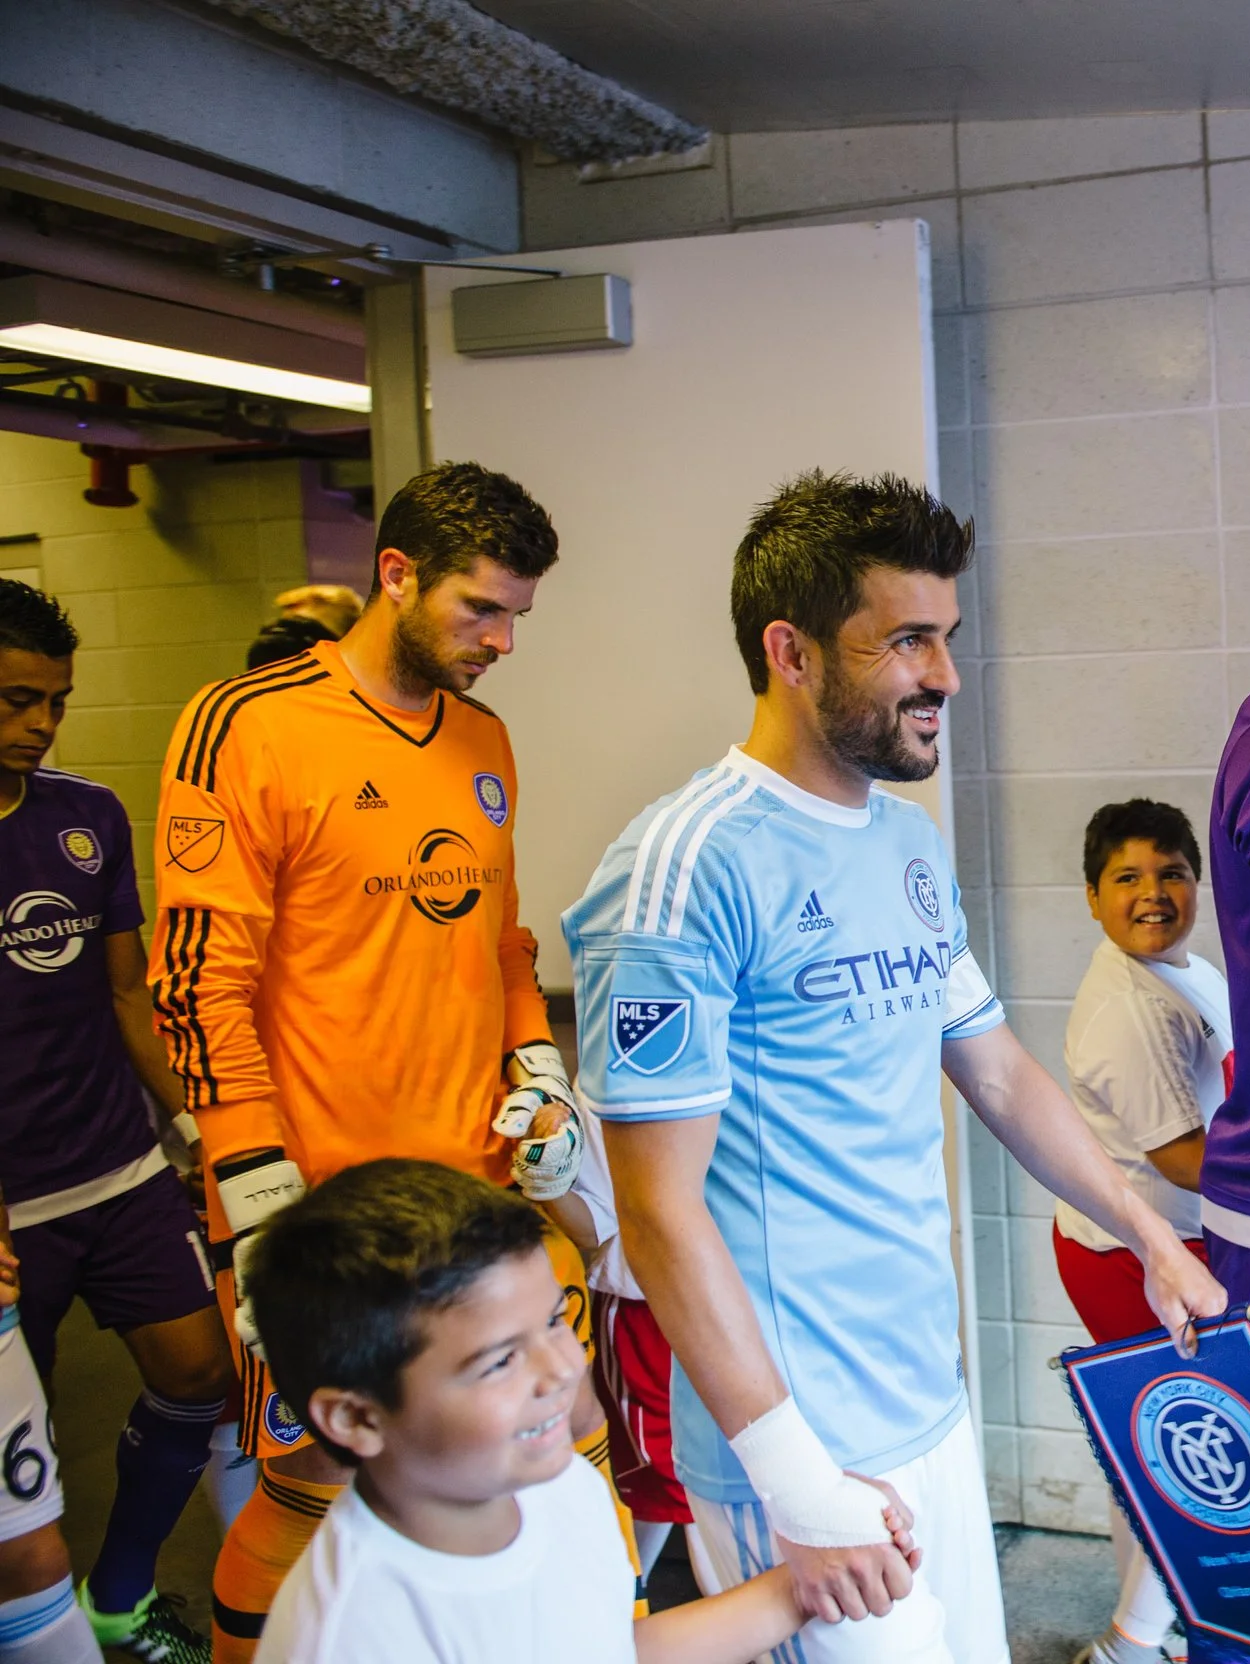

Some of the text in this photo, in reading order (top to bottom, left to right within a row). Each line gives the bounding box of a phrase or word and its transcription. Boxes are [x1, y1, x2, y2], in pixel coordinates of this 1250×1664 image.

[354, 799, 389, 810] adidas
[173, 821, 202, 833] MLS
[364, 870, 454, 896] ORLANDO
[797, 916, 834, 933] adidas
[0, 925, 54, 948] ANDO
[793, 941, 950, 1003] ETIHAD
[619, 1003, 660, 1021] MLS
[841, 988, 946, 1025] AIRWAY
[3, 1406, 58, 1502] 6
